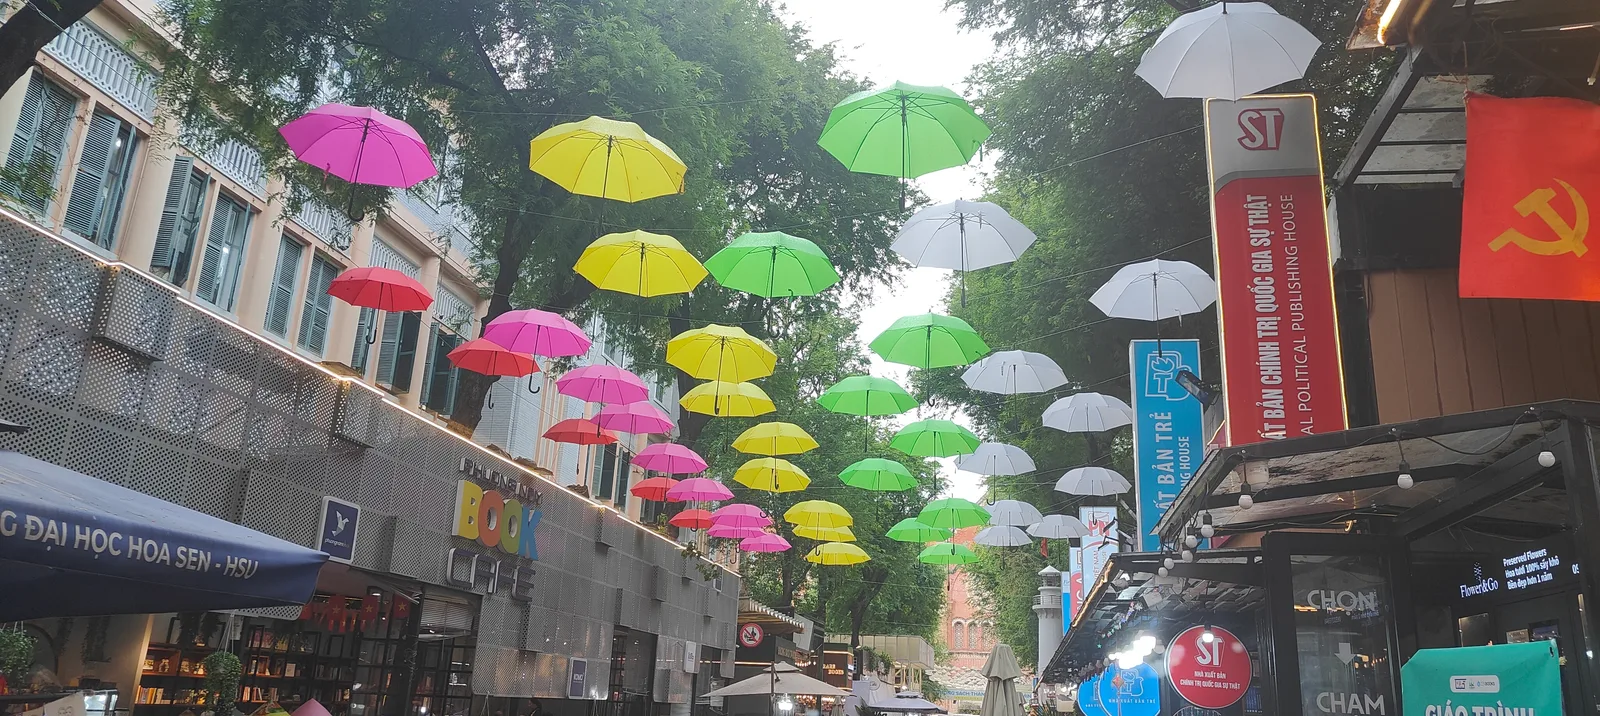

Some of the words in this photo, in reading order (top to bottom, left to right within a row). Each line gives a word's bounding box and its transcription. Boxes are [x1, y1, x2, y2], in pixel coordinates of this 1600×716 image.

[1238, 108, 1284, 150] ST
[1243, 195, 1272, 226] THẬT
[1280, 194, 1297, 241] HOUSE
[1247, 228, 1274, 247] SỰ
[1251, 250, 1274, 273] GIA
[1247, 276, 1279, 312] QUỐC
[1284, 246, 1305, 331] PUBLISHING
[1256, 316, 1281, 338] TRỊ
[1256, 342, 1283, 385] CHÍNH
[1293, 336, 1312, 411] POLITICAL
[1256, 389, 1286, 418] BẢN
[1149, 411, 1173, 443] TRẺ
[1152, 449, 1175, 485] BẢN
[1178, 436, 1191, 470] HOUSE
[452, 479, 543, 561] BOOK
[24, 514, 67, 551] ĐẠI
[73, 524, 123, 560] HỌC
[127, 535, 171, 565] HOA
[174, 546, 211, 573] SEN
[223, 555, 259, 579] HSU
[1503, 552, 1527, 567] Preserved
[1526, 548, 1547, 561] Flowers
[1505, 568, 1515, 578] Hoa
[1526, 562, 1540, 573] 100%
[1548, 555, 1560, 567] khô
[1537, 574, 1541, 583] 1
[1307, 589, 1376, 616] CHỌN
